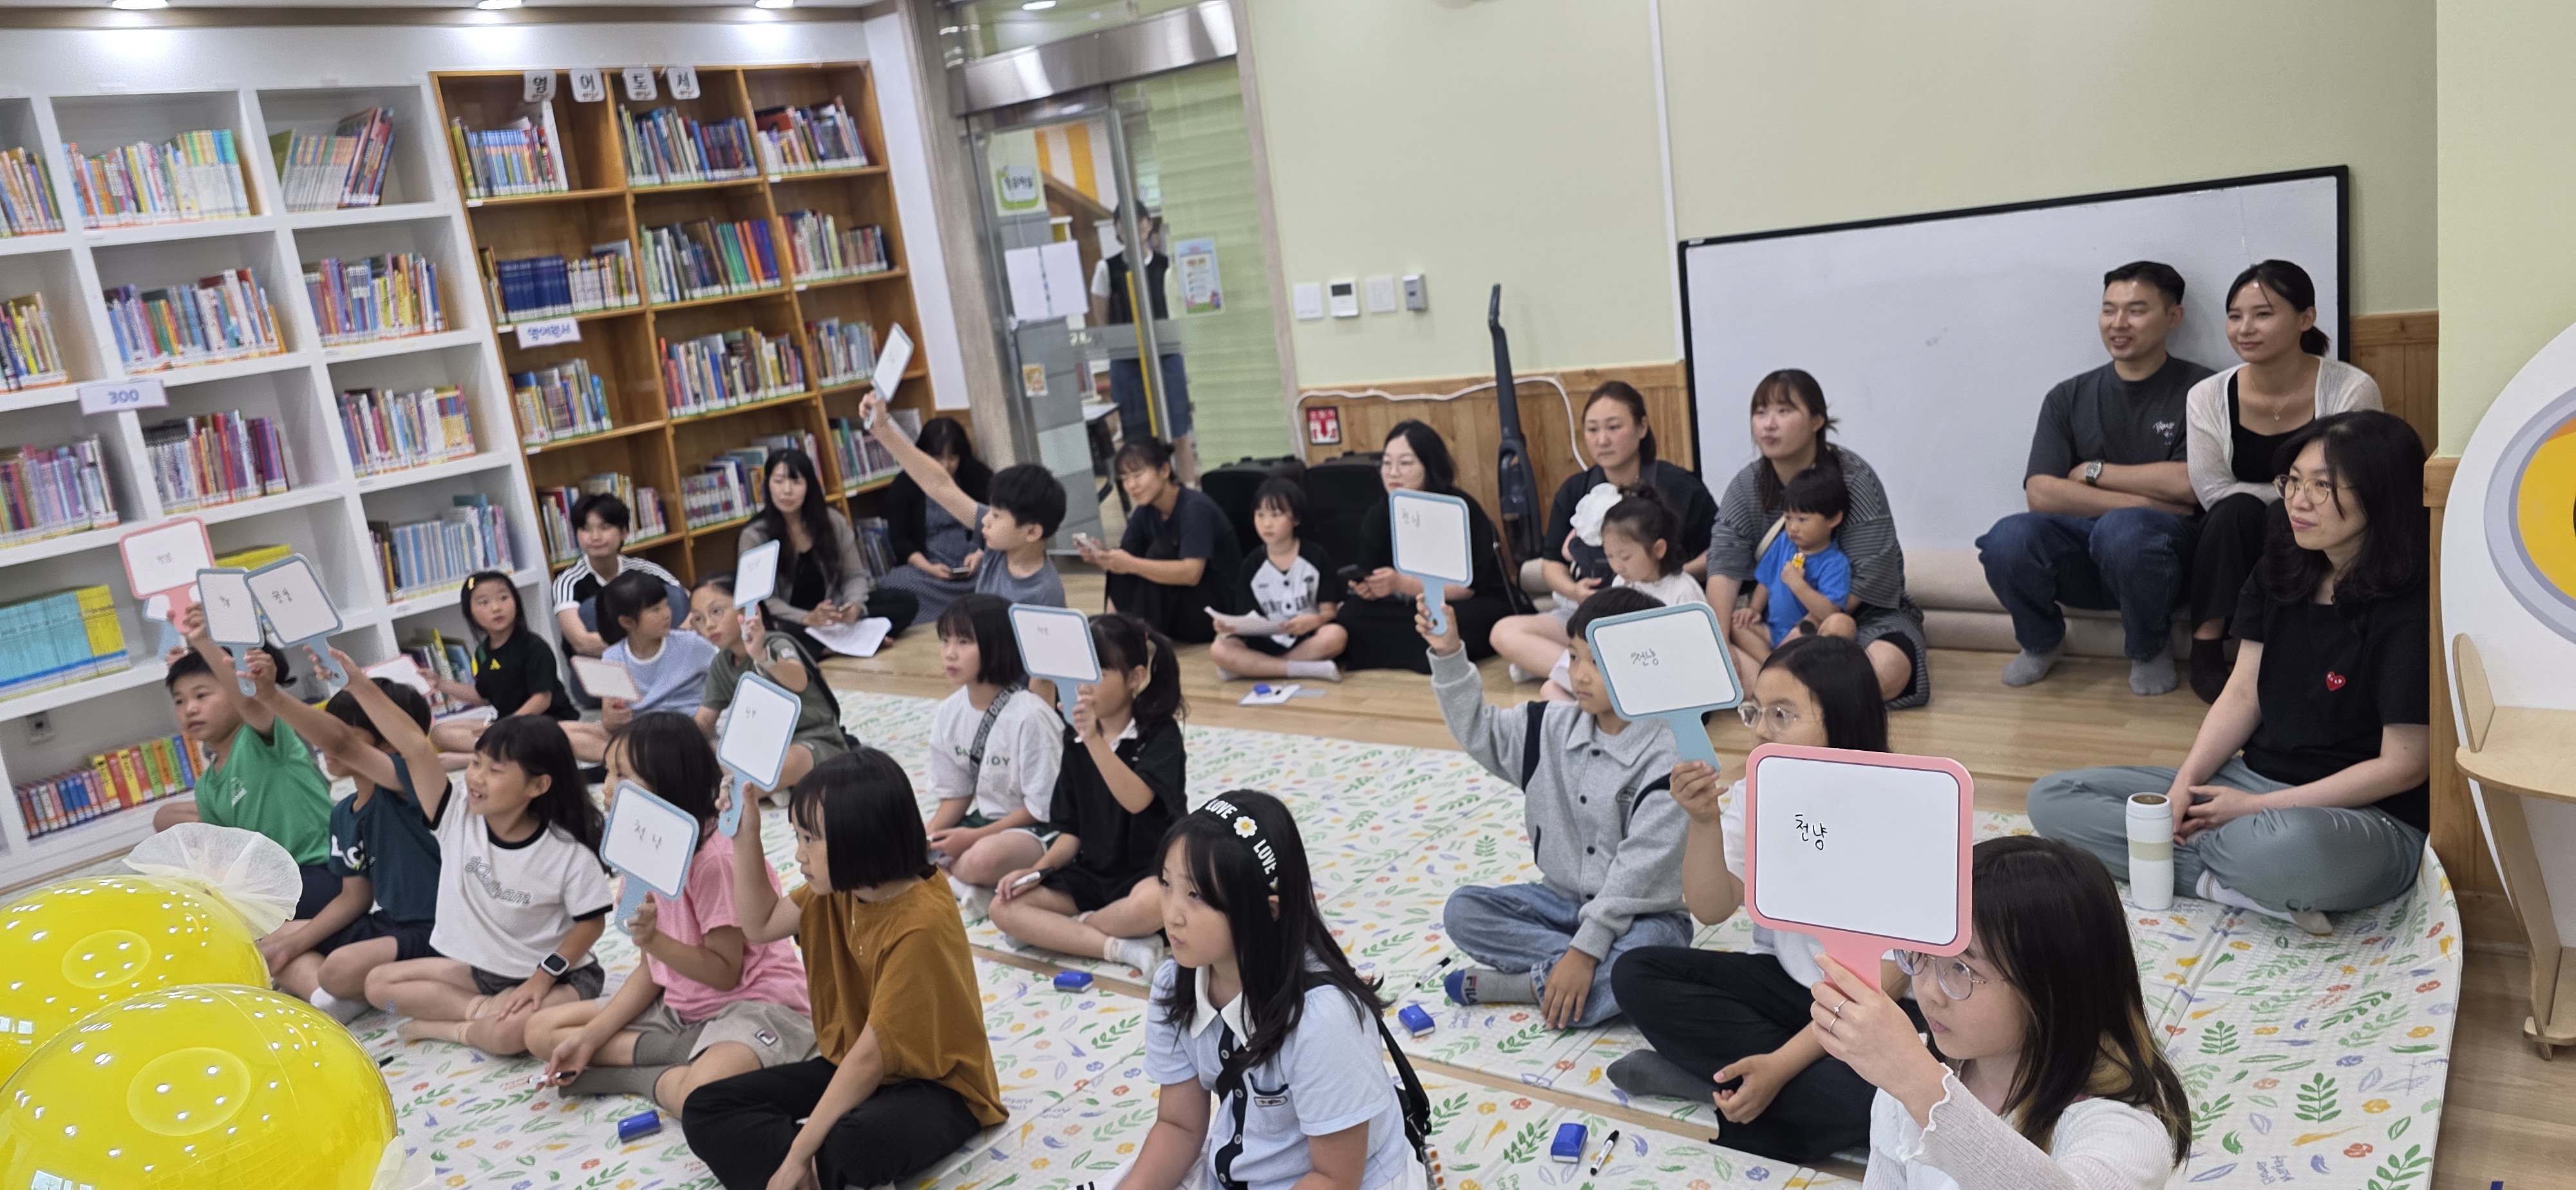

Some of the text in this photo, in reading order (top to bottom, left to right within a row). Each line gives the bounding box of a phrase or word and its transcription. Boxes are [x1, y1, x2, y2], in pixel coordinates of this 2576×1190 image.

[580, 73, 595, 92] 어
[108, 388, 139, 405] 300
[1205, 798, 1238, 819] LOVE
[1795, 814, 1828, 851] 천냥
[1253, 839, 1277, 875] LOVE
[1464, 976, 1478, 1005] FILA
